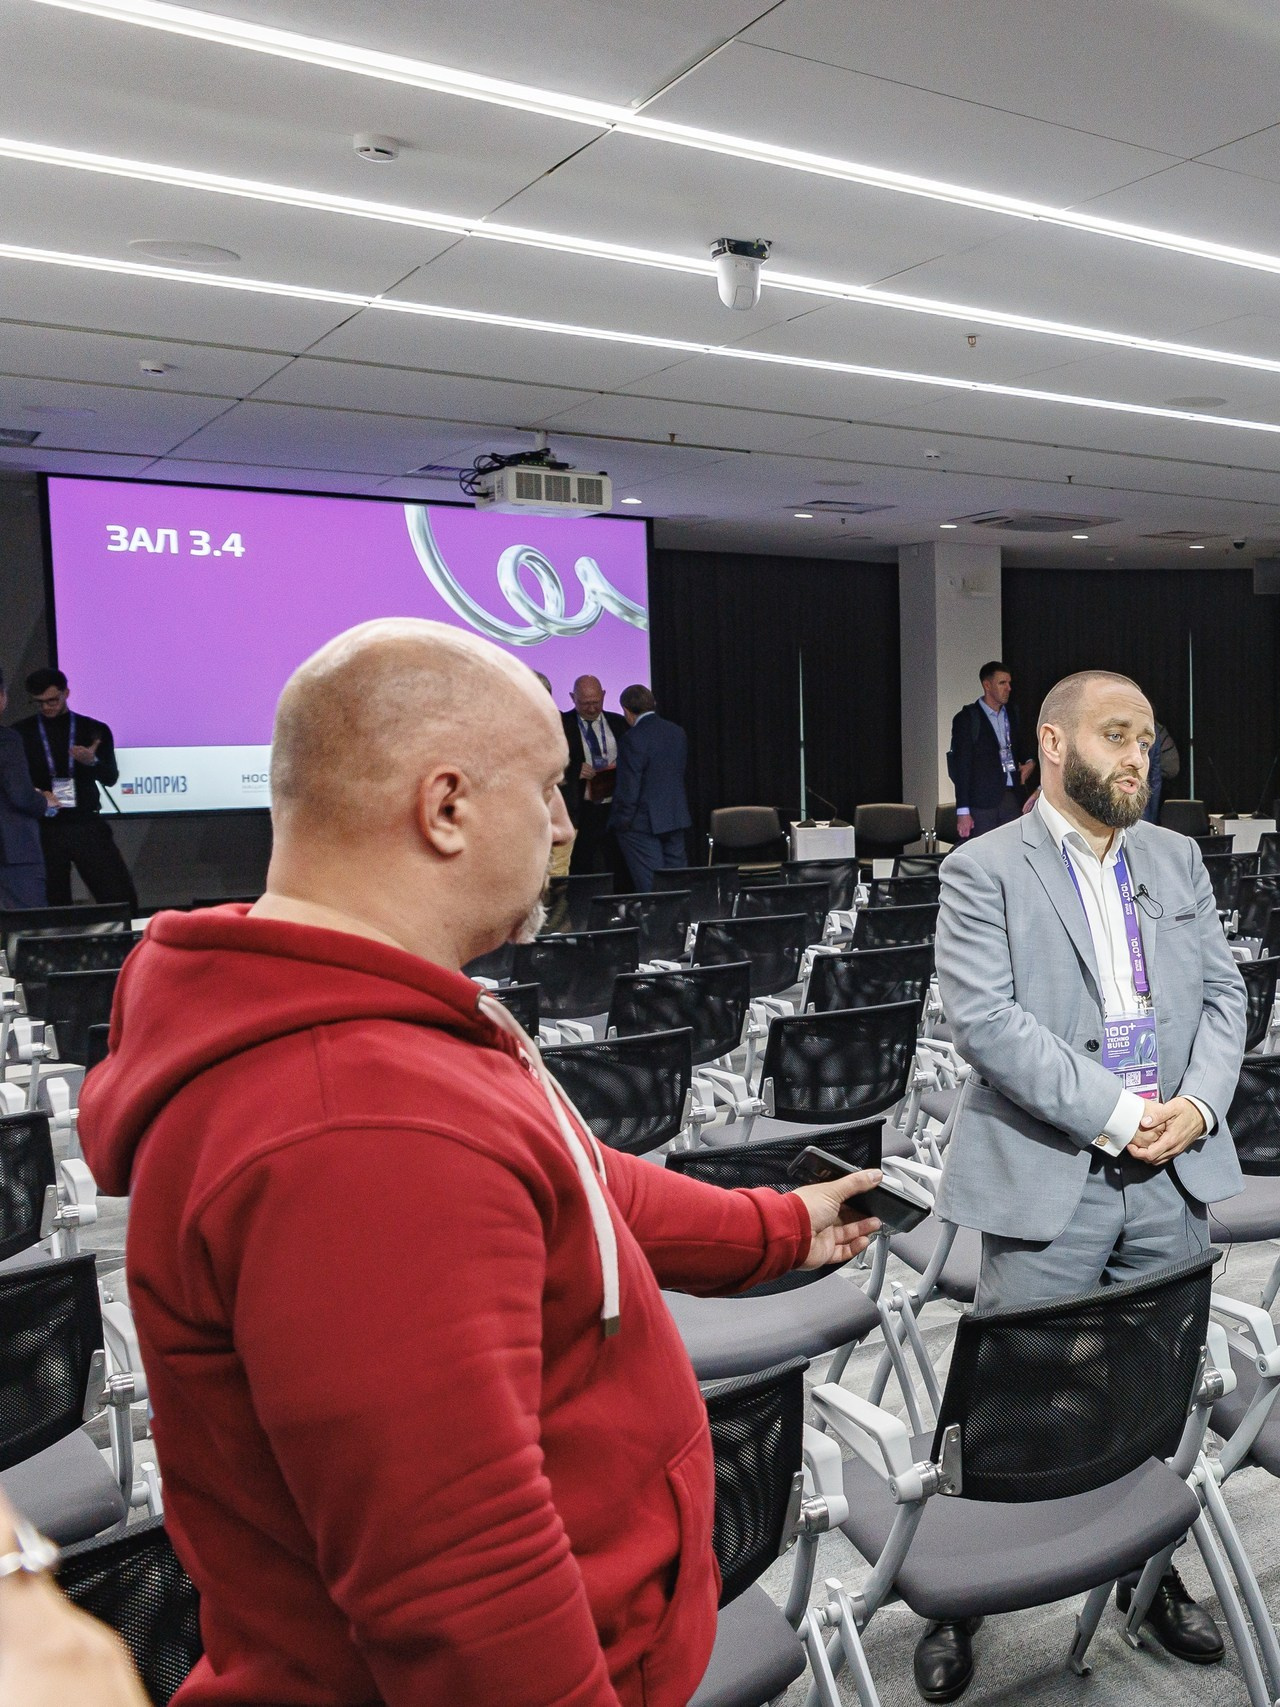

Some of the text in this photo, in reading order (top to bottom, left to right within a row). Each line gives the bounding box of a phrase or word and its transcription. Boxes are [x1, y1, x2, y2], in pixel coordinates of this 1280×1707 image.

[105, 524, 246, 557] ЗАЛ 3.4
[134, 775, 188, 794] НОПРИЗ
[241, 773, 271, 783] НОС
[1107, 1041, 1130, 1050] BUILD
